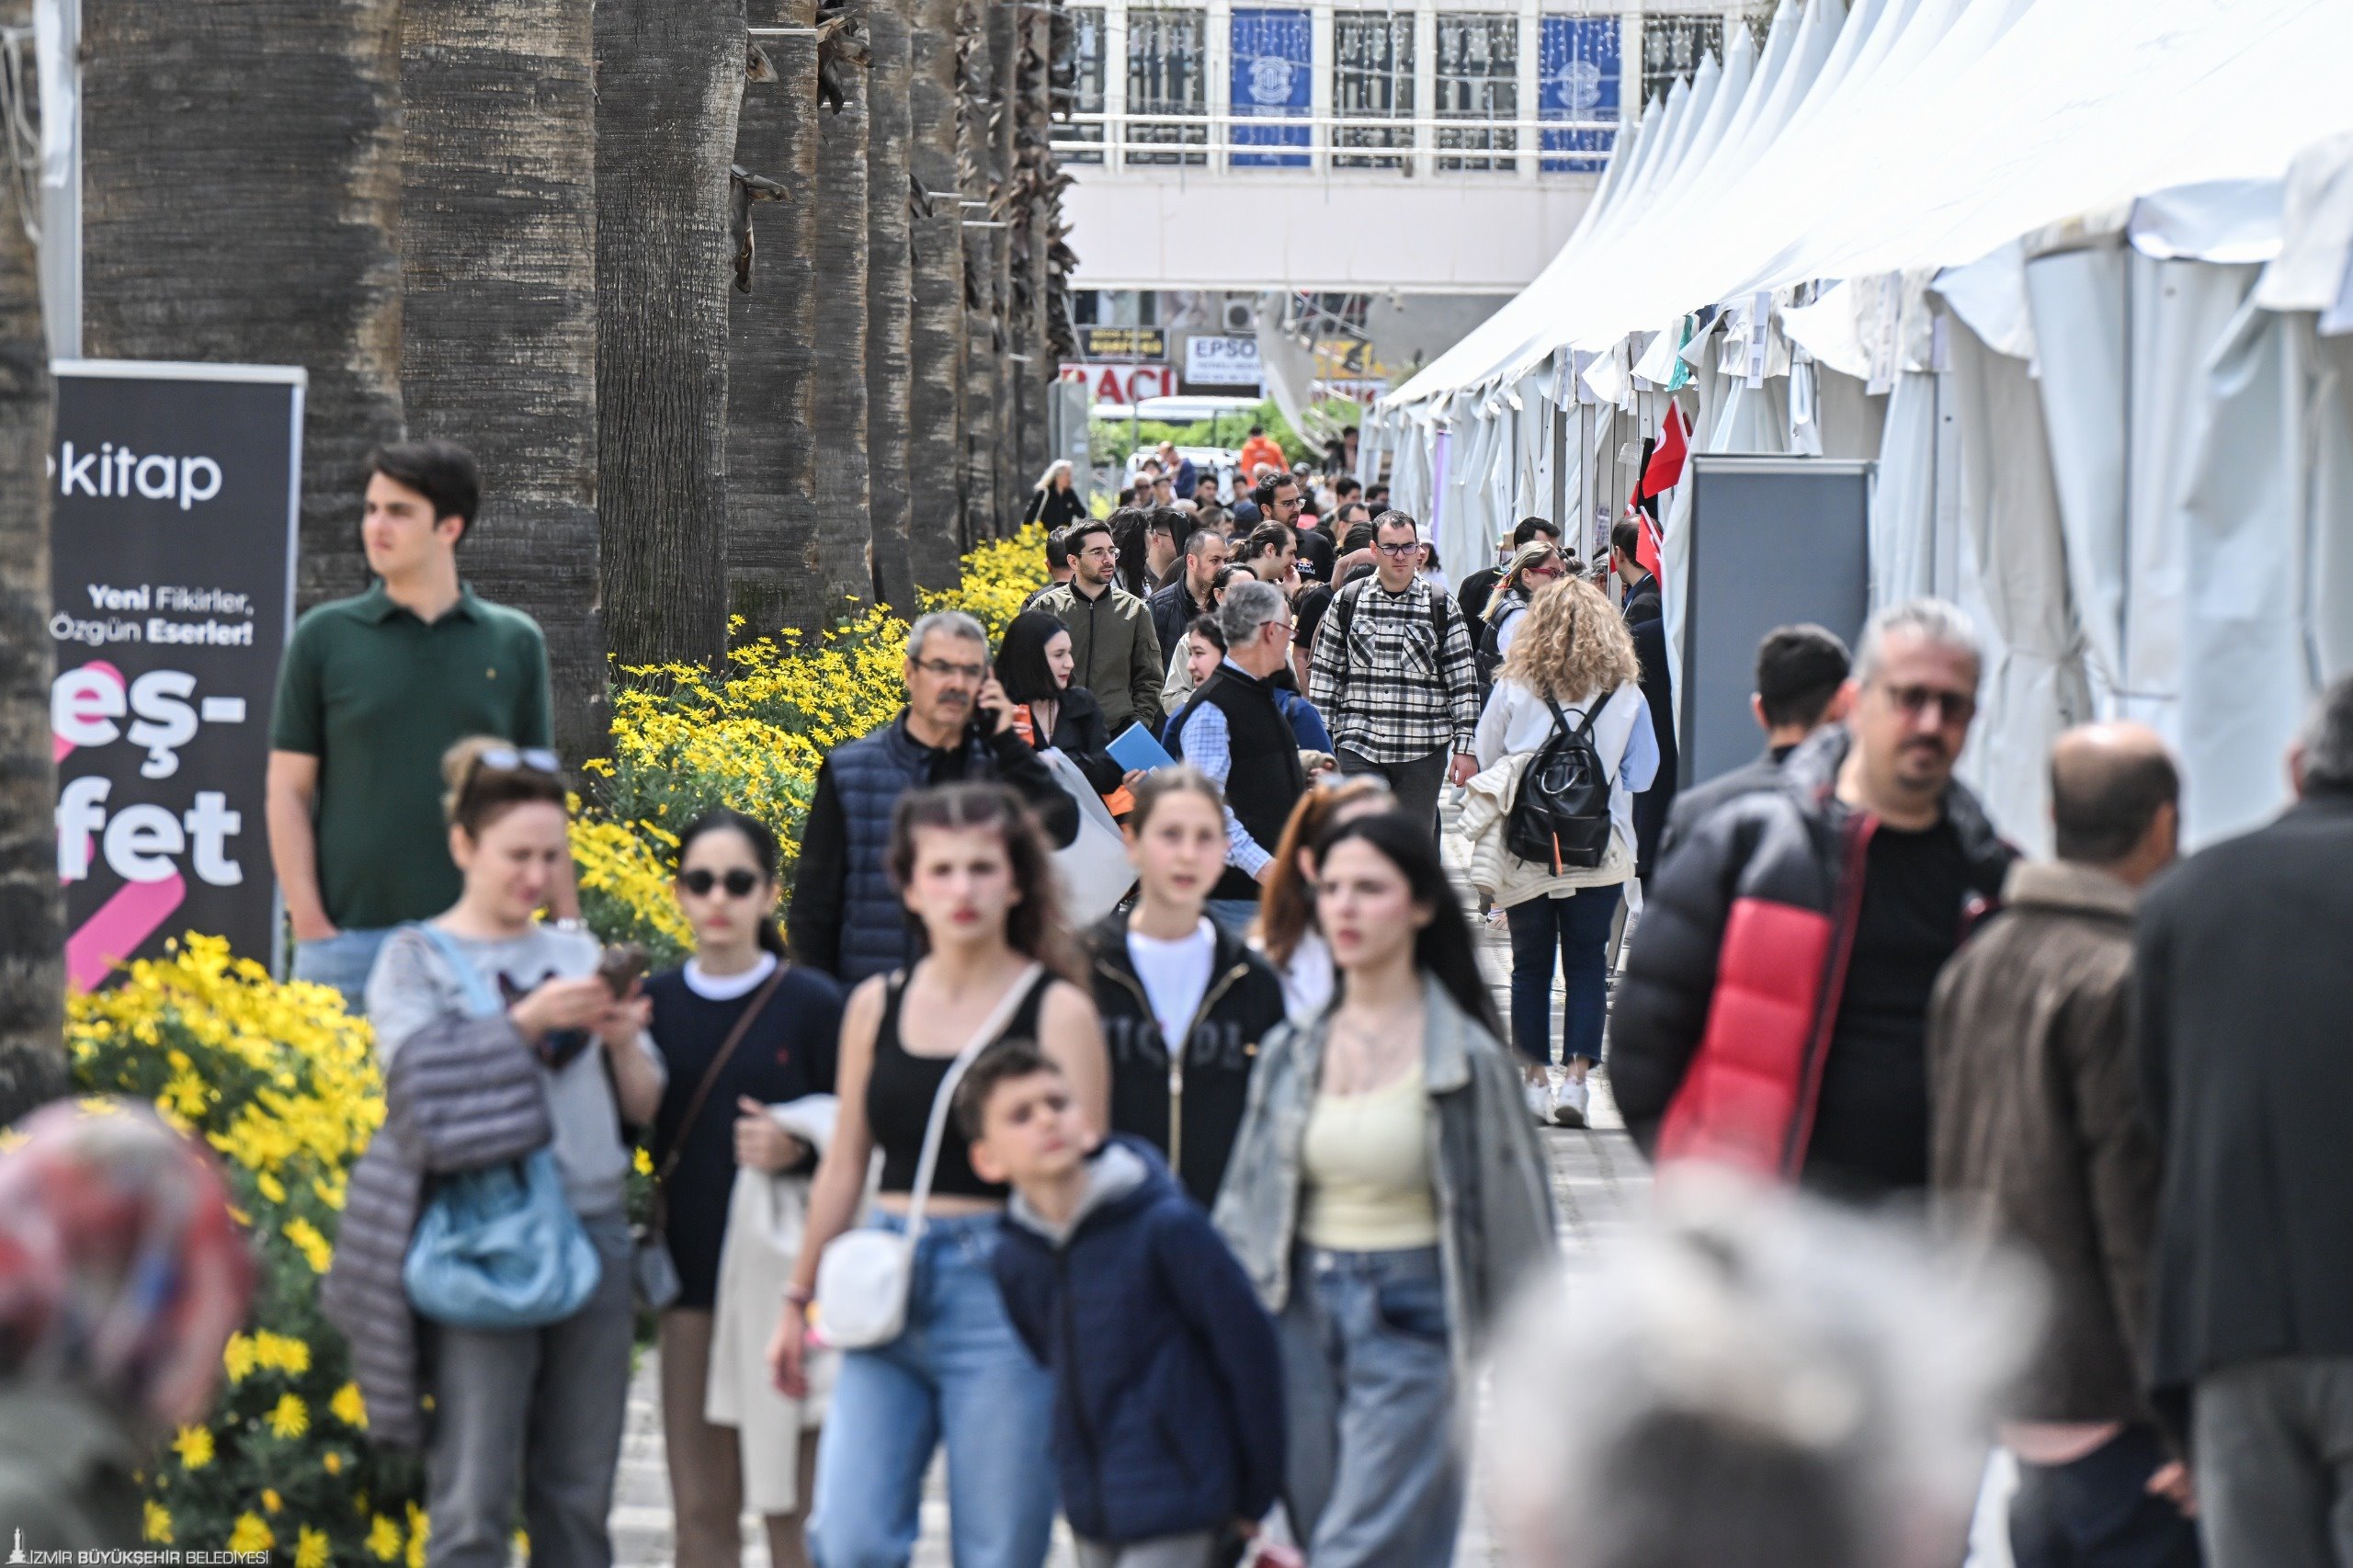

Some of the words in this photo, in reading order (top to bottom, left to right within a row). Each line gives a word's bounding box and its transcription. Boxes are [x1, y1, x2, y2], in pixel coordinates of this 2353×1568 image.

[87, 584, 150, 611] Yeni
[49, 609, 142, 647] Özgün
[146, 618, 254, 647] Eserler!
[54, 776, 244, 887] fet
